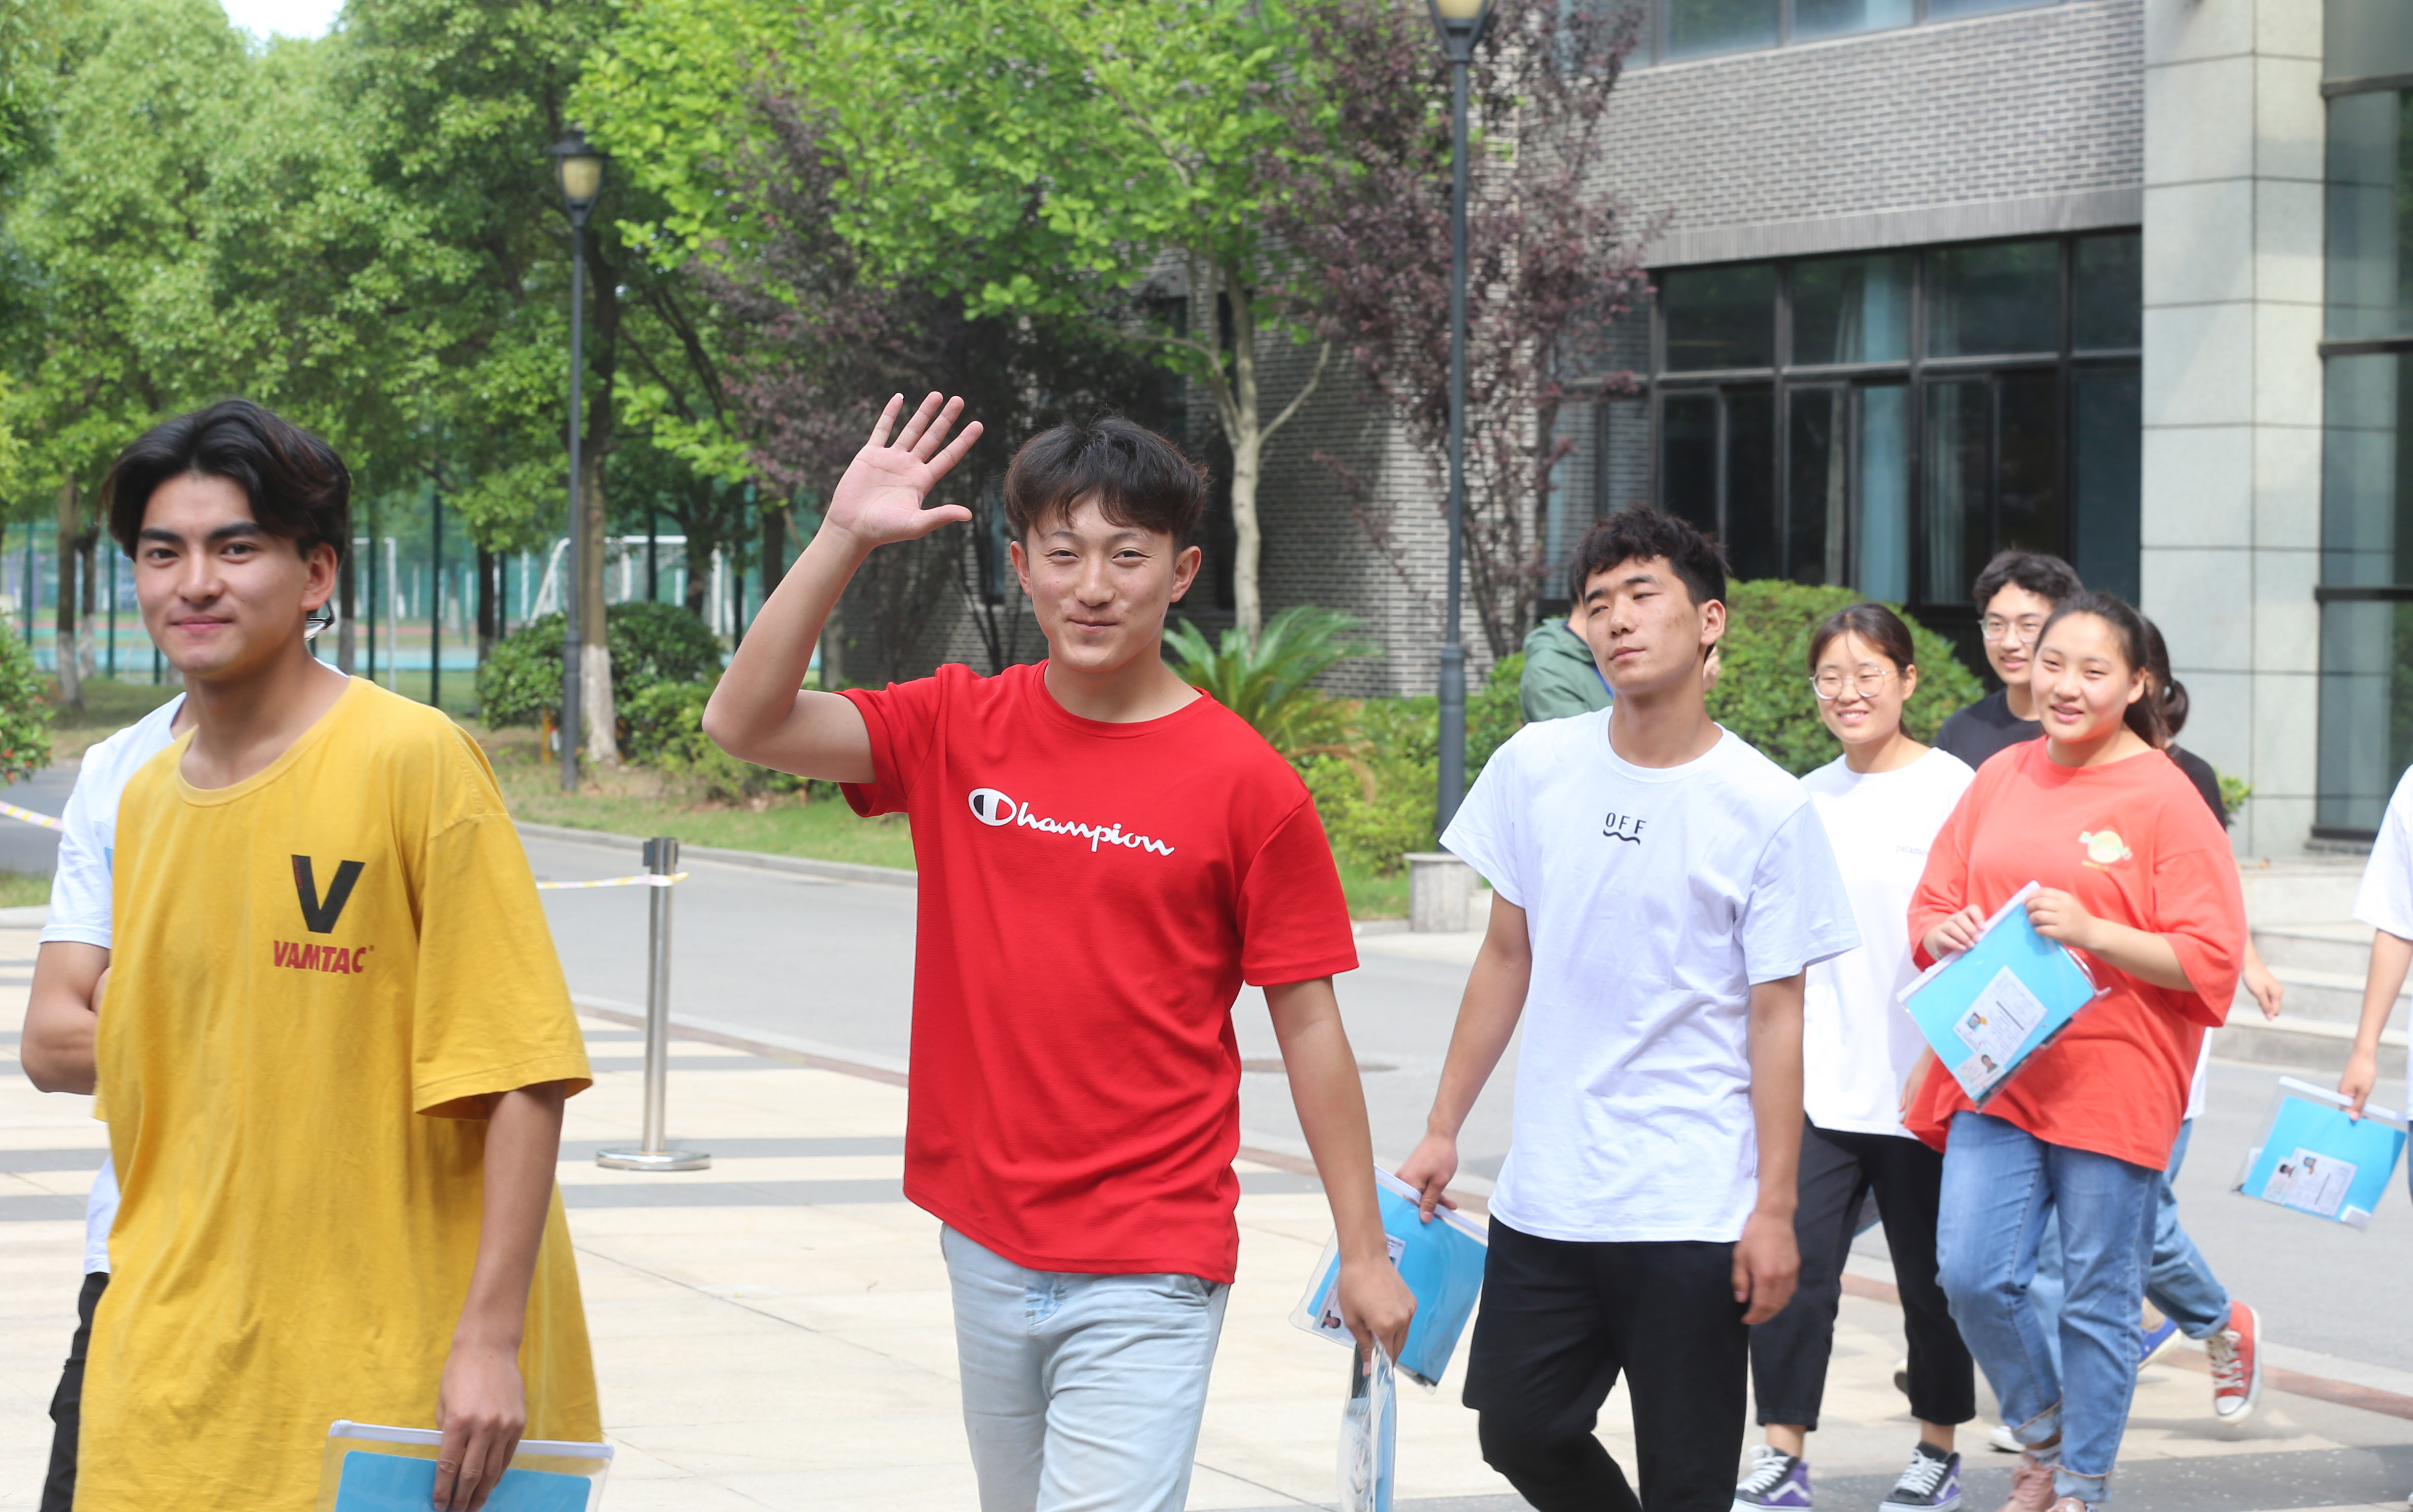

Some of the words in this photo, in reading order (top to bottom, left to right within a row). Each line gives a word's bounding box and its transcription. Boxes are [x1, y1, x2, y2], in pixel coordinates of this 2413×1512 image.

[967, 788, 1176, 856] Champion
[291, 854, 366, 934] V
[273, 940, 367, 974] VAMTAC
